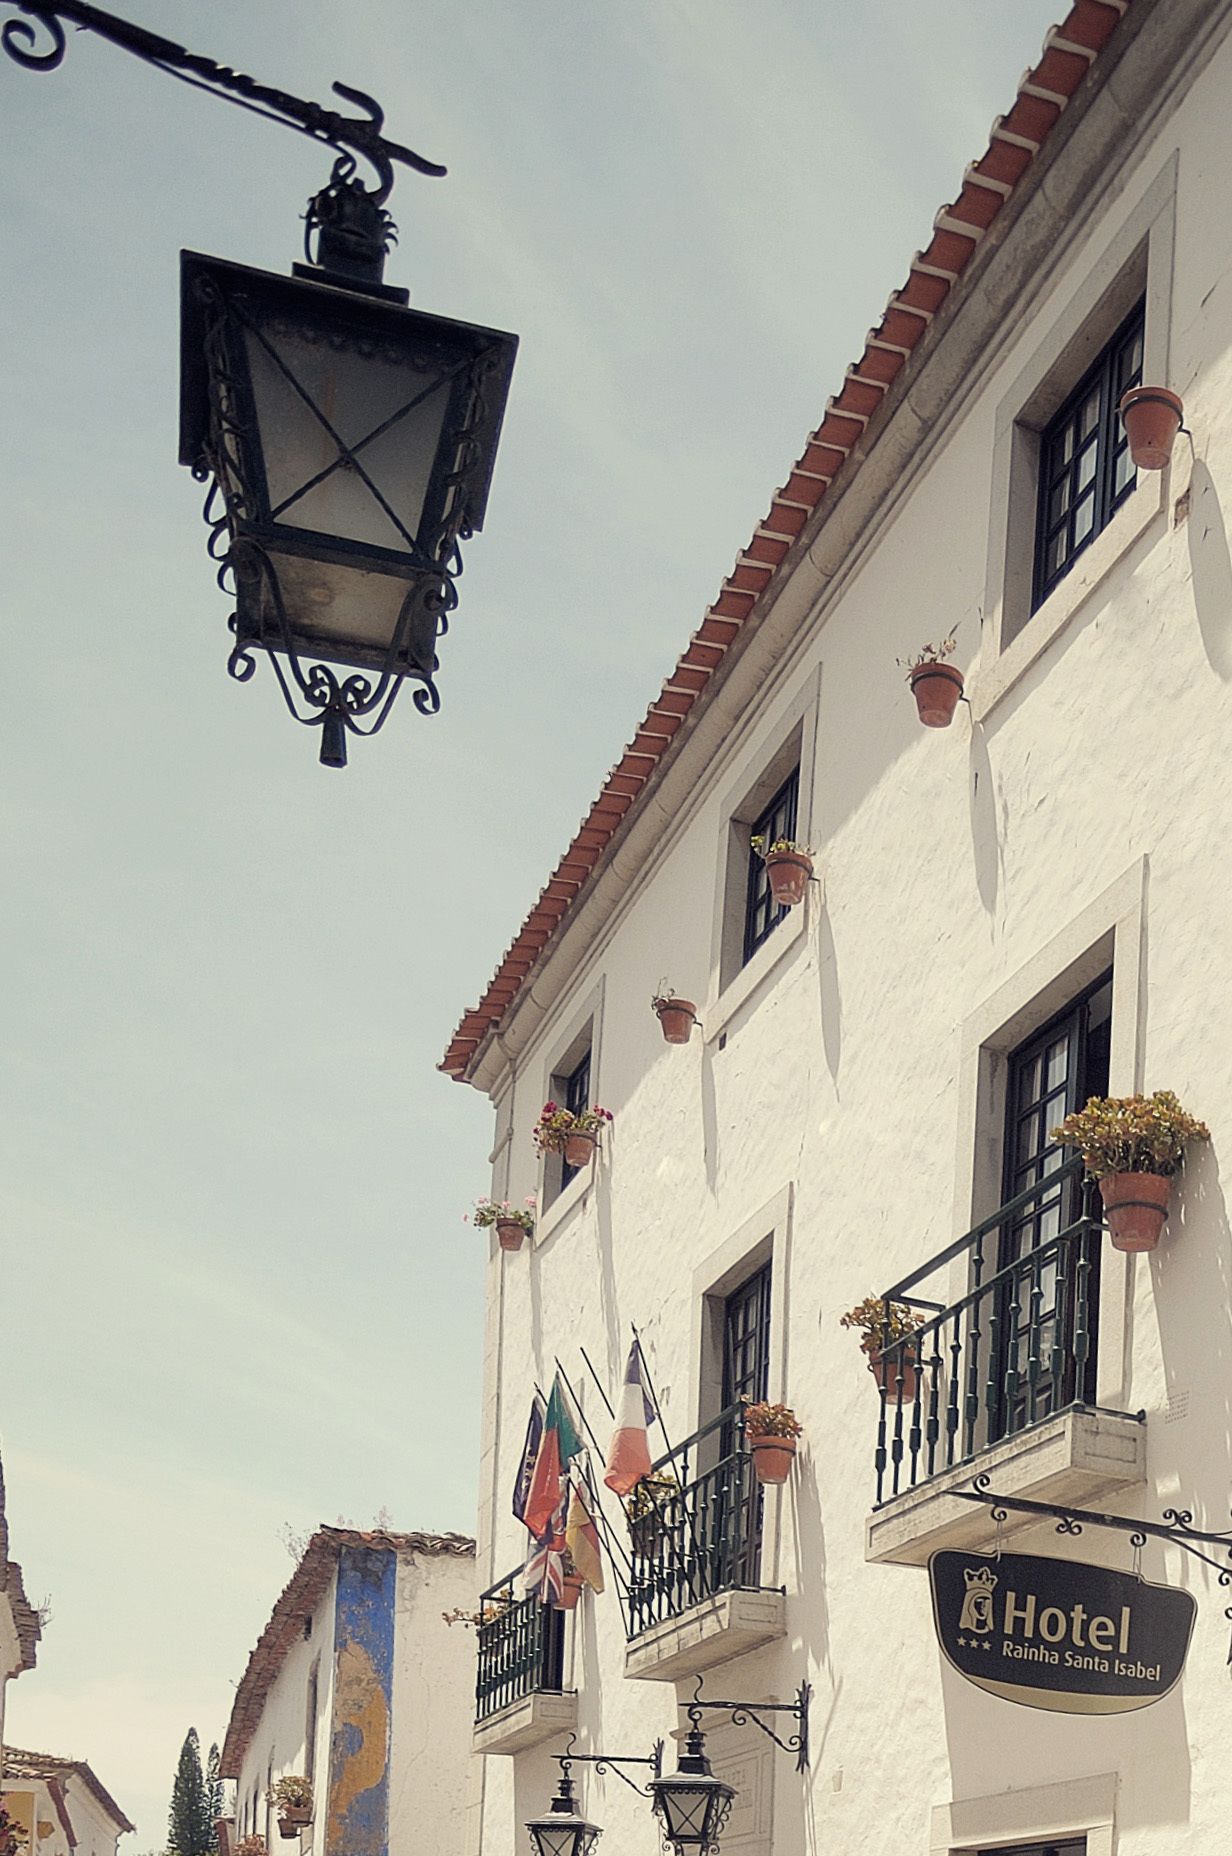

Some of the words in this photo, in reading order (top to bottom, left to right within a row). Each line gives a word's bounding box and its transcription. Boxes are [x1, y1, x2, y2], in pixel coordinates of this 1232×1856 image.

[1003, 1591, 1131, 1654] Hotel
[1003, 1641, 1059, 1665] Rainha
[1064, 1651, 1109, 1673] Santa
[1115, 1659, 1161, 1681] Isabel
